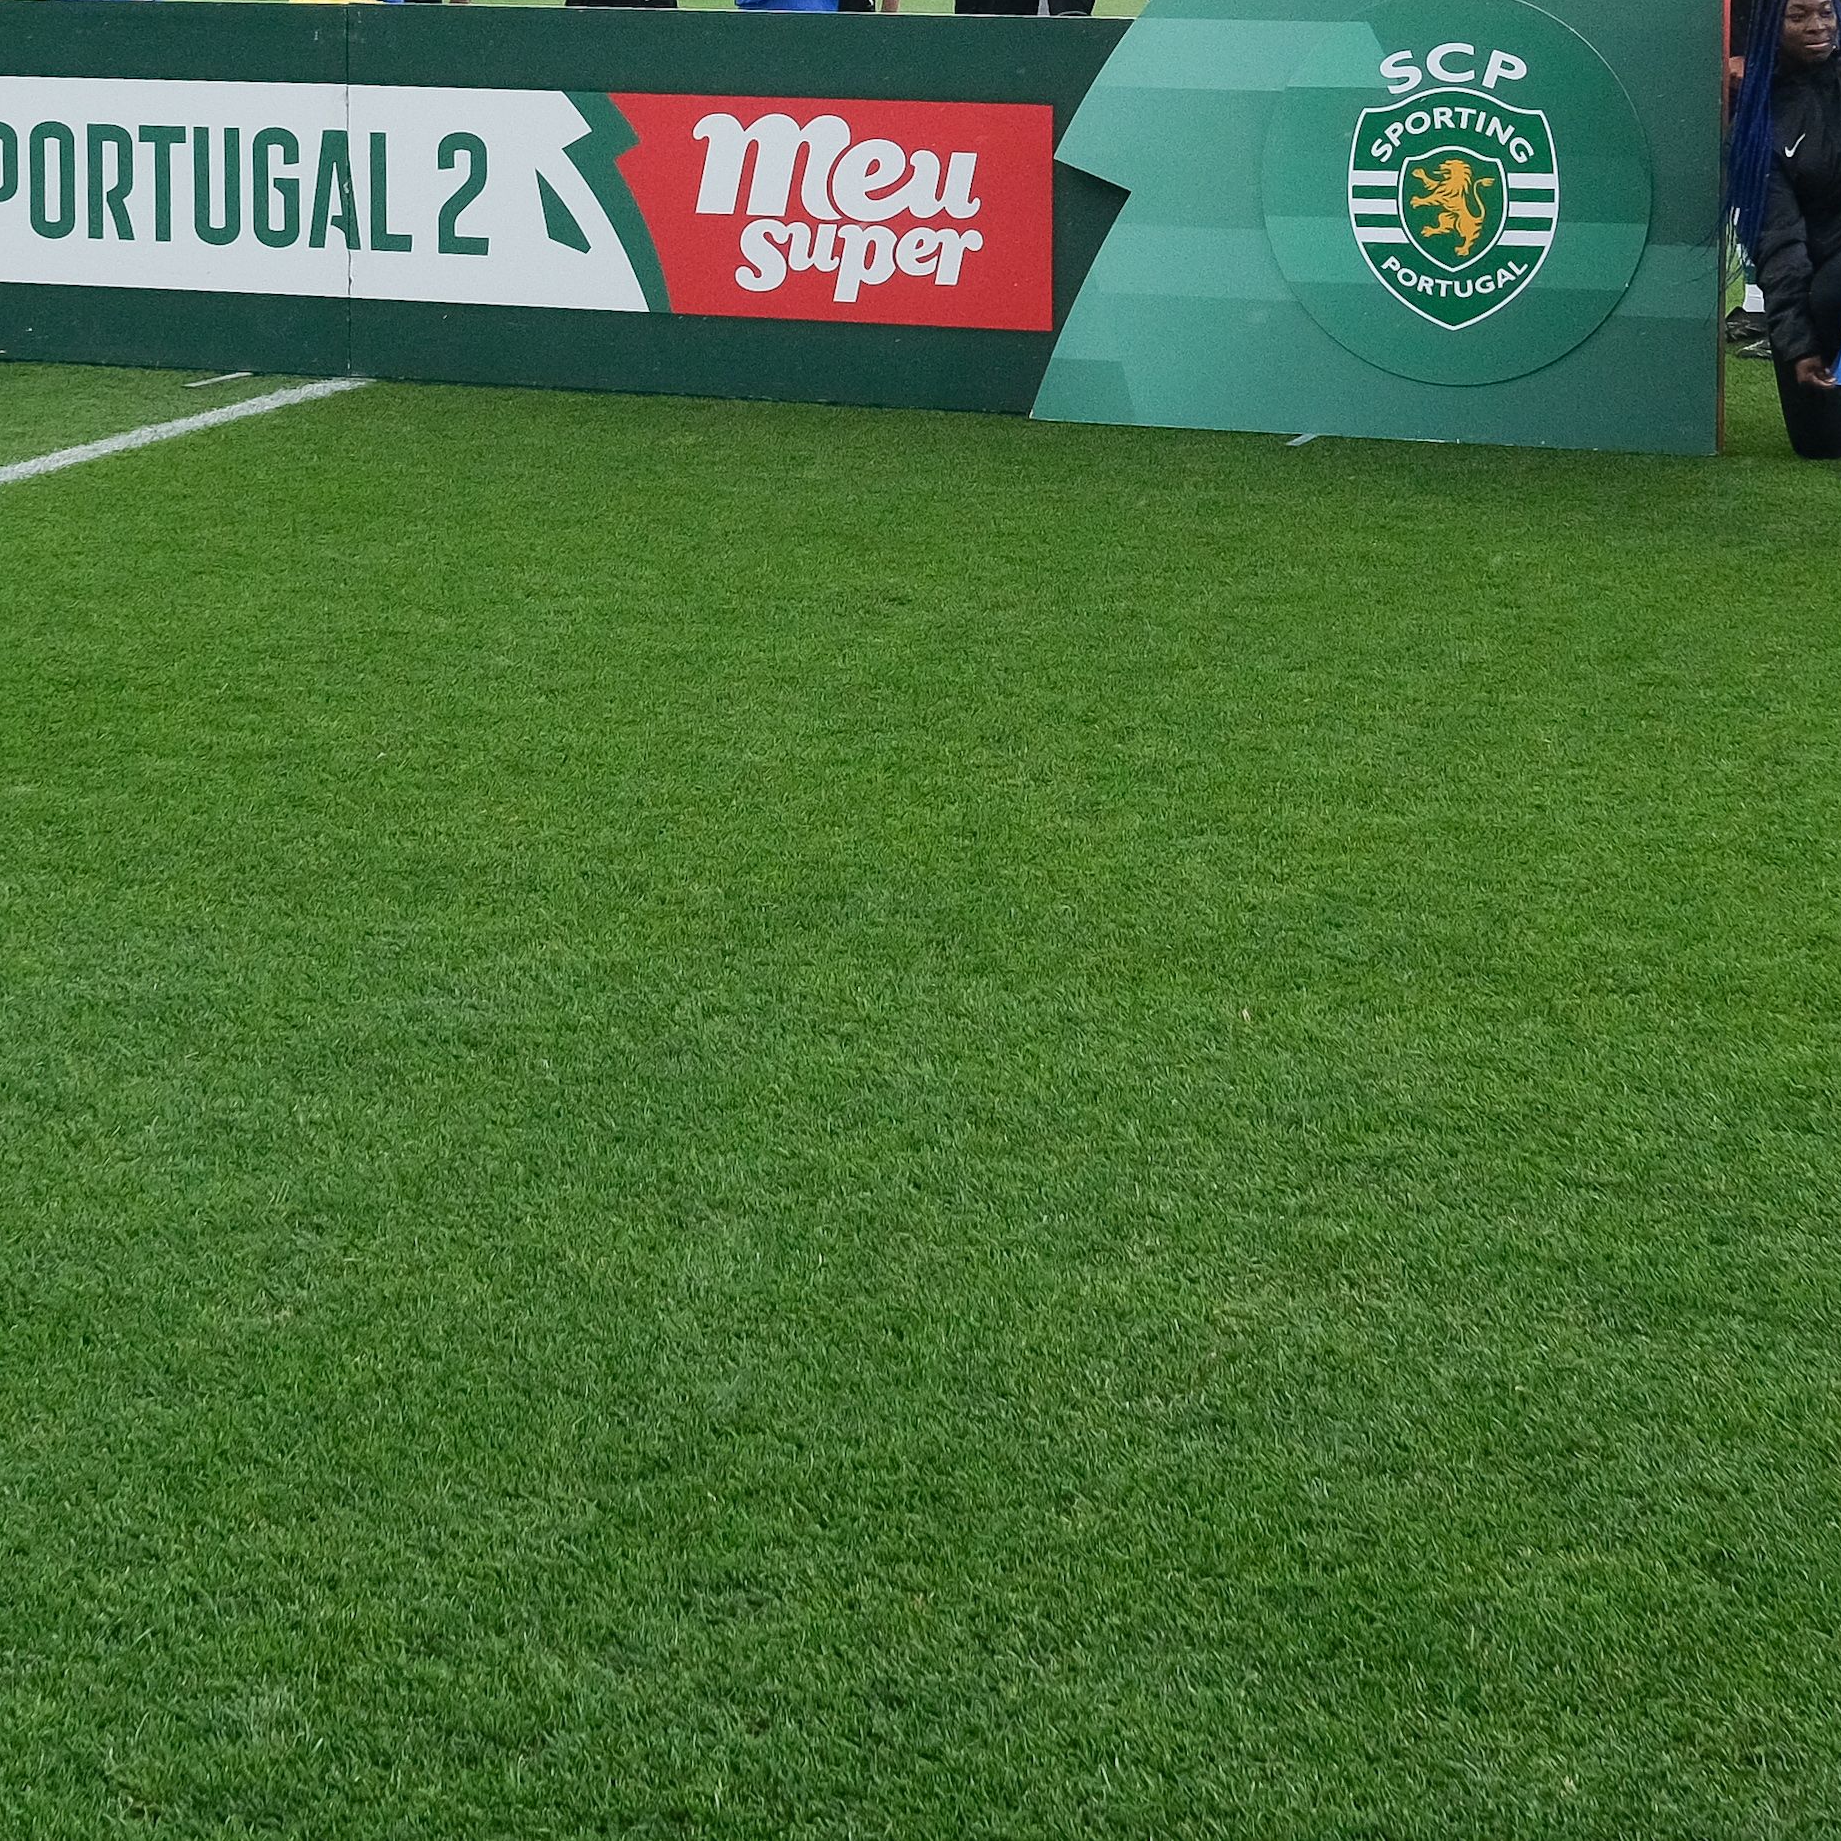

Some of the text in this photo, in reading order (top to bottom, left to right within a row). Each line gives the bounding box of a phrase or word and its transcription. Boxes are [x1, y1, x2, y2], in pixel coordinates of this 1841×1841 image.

[1379, 42, 1527, 95] SCP
[1370, 106, 1535, 164] SPORTING
[437, 132, 490, 255] 2
[735, 219, 984, 303] super
[1381, 255, 1529, 299] PORTUGAL
